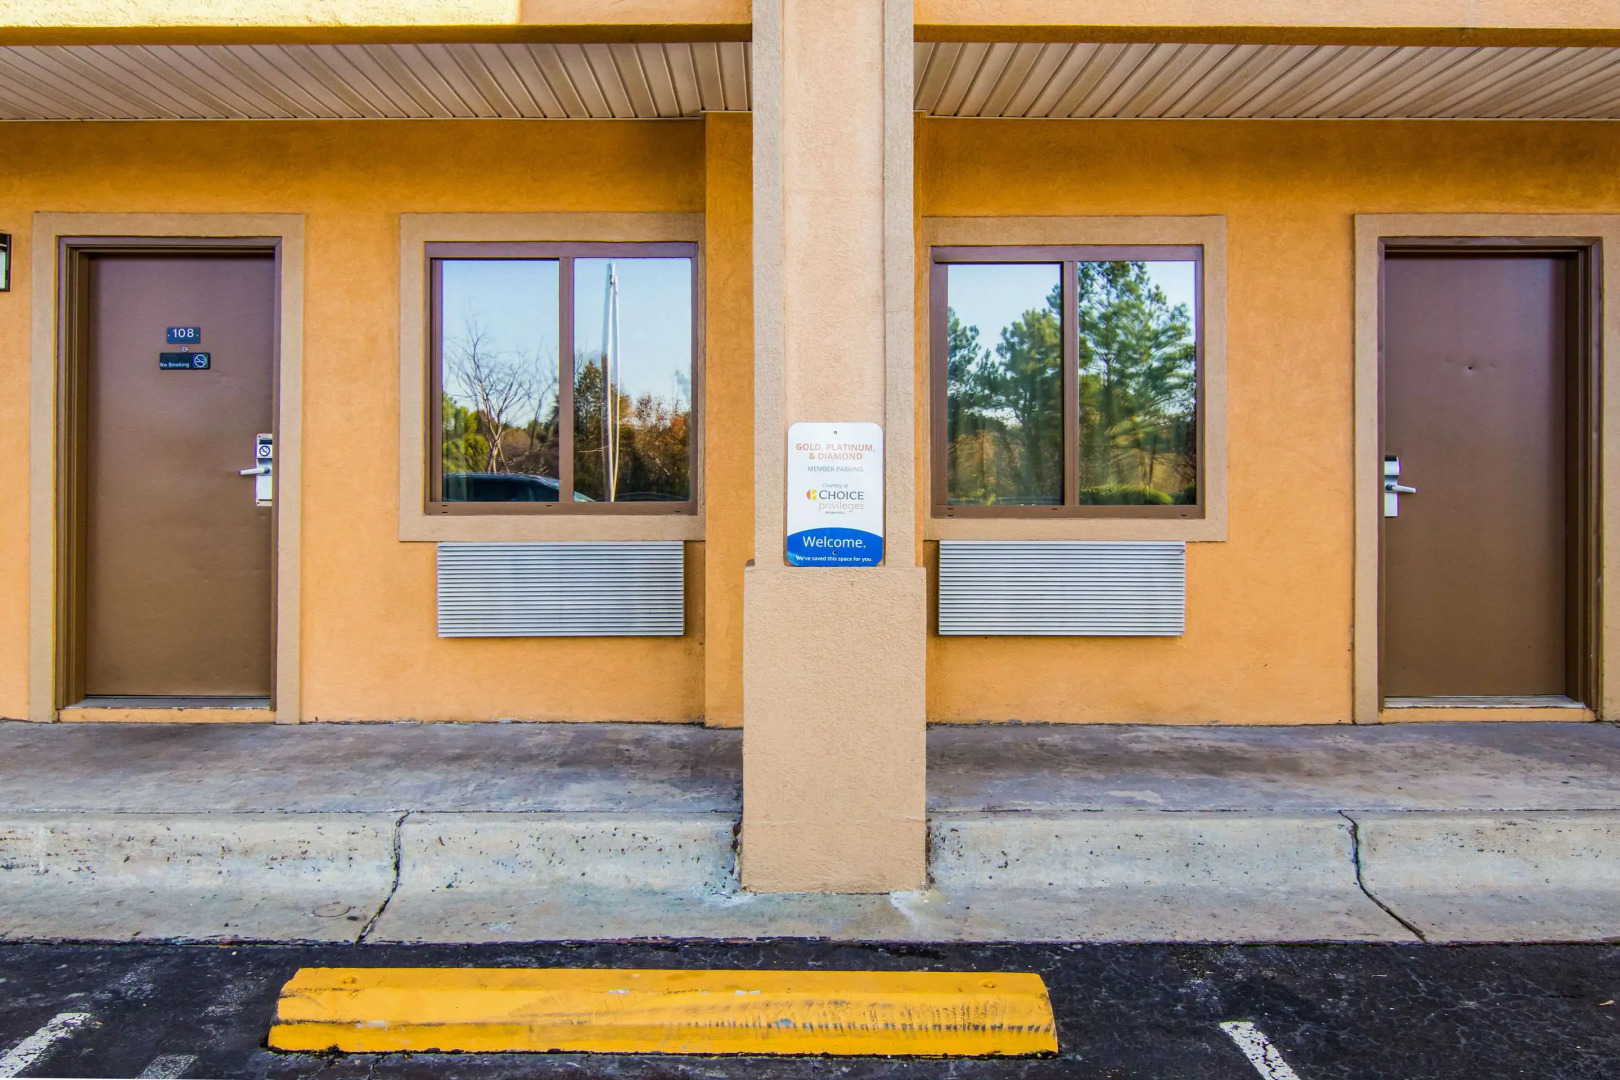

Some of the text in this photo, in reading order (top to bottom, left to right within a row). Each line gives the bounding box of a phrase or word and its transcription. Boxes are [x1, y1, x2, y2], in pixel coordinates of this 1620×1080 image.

[172, 328, 194, 338] 108
[796, 443, 876, 452] GOLD, PLATINUM,
[818, 490, 864, 500] CHOICE
[818, 500, 864, 512] privileges
[802, 536, 866, 548] Welcome.
